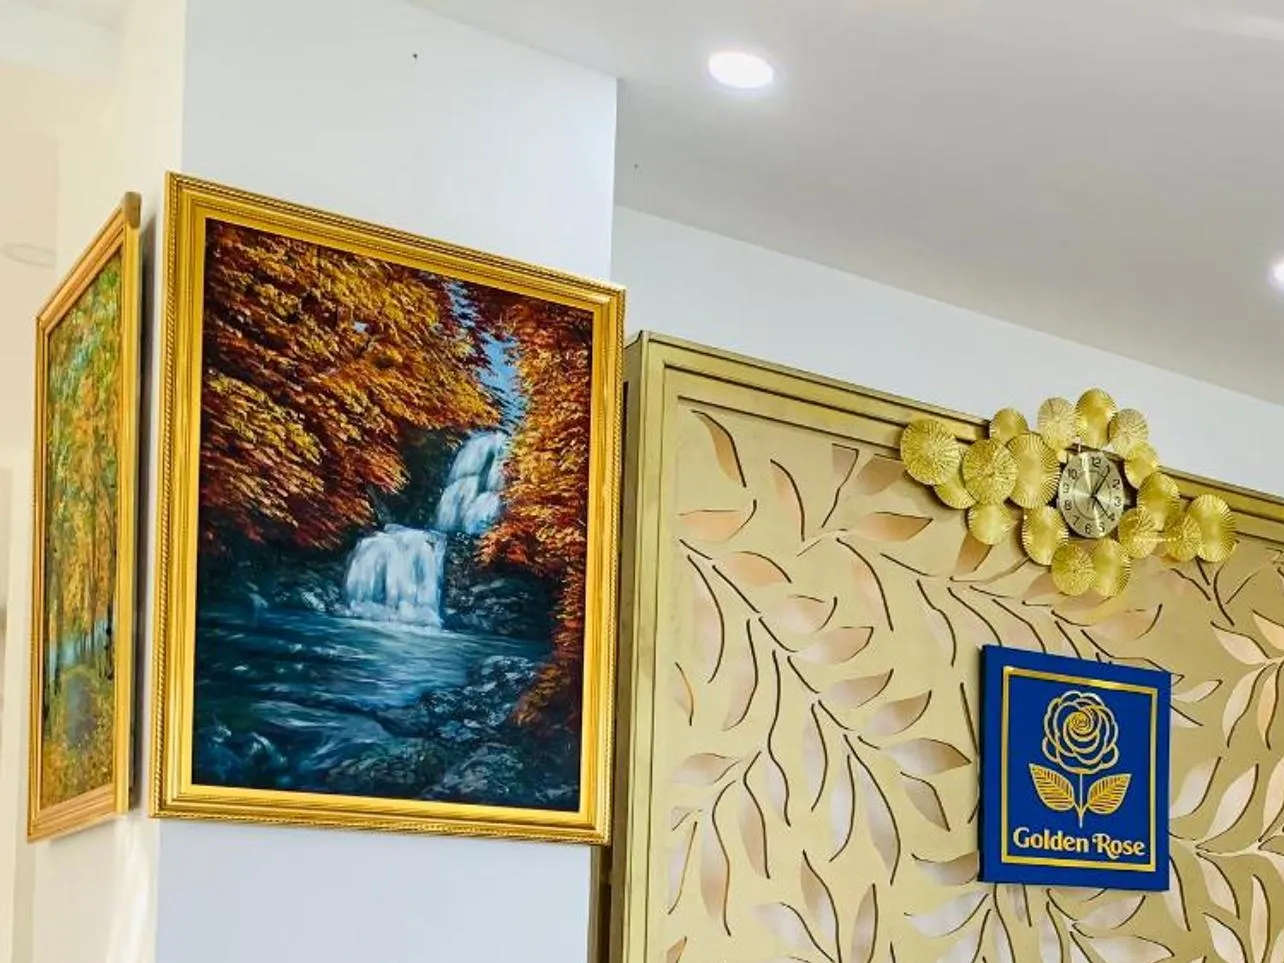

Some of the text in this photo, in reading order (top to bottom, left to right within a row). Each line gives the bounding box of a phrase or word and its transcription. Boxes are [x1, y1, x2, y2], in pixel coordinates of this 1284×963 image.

[1091, 457, 1101, 468] 12
[1068, 469, 1078, 480] 10
[1112, 479, 1120, 489] 2
[1064, 500, 1072, 510] 8
[1114, 496, 1121, 507] 3
[1073, 515, 1080, 525] 7
[1107, 513, 1115, 522] 4
[1085, 524, 1093, 534] 6
[1013, 827, 1145, 860] Golden Rose
